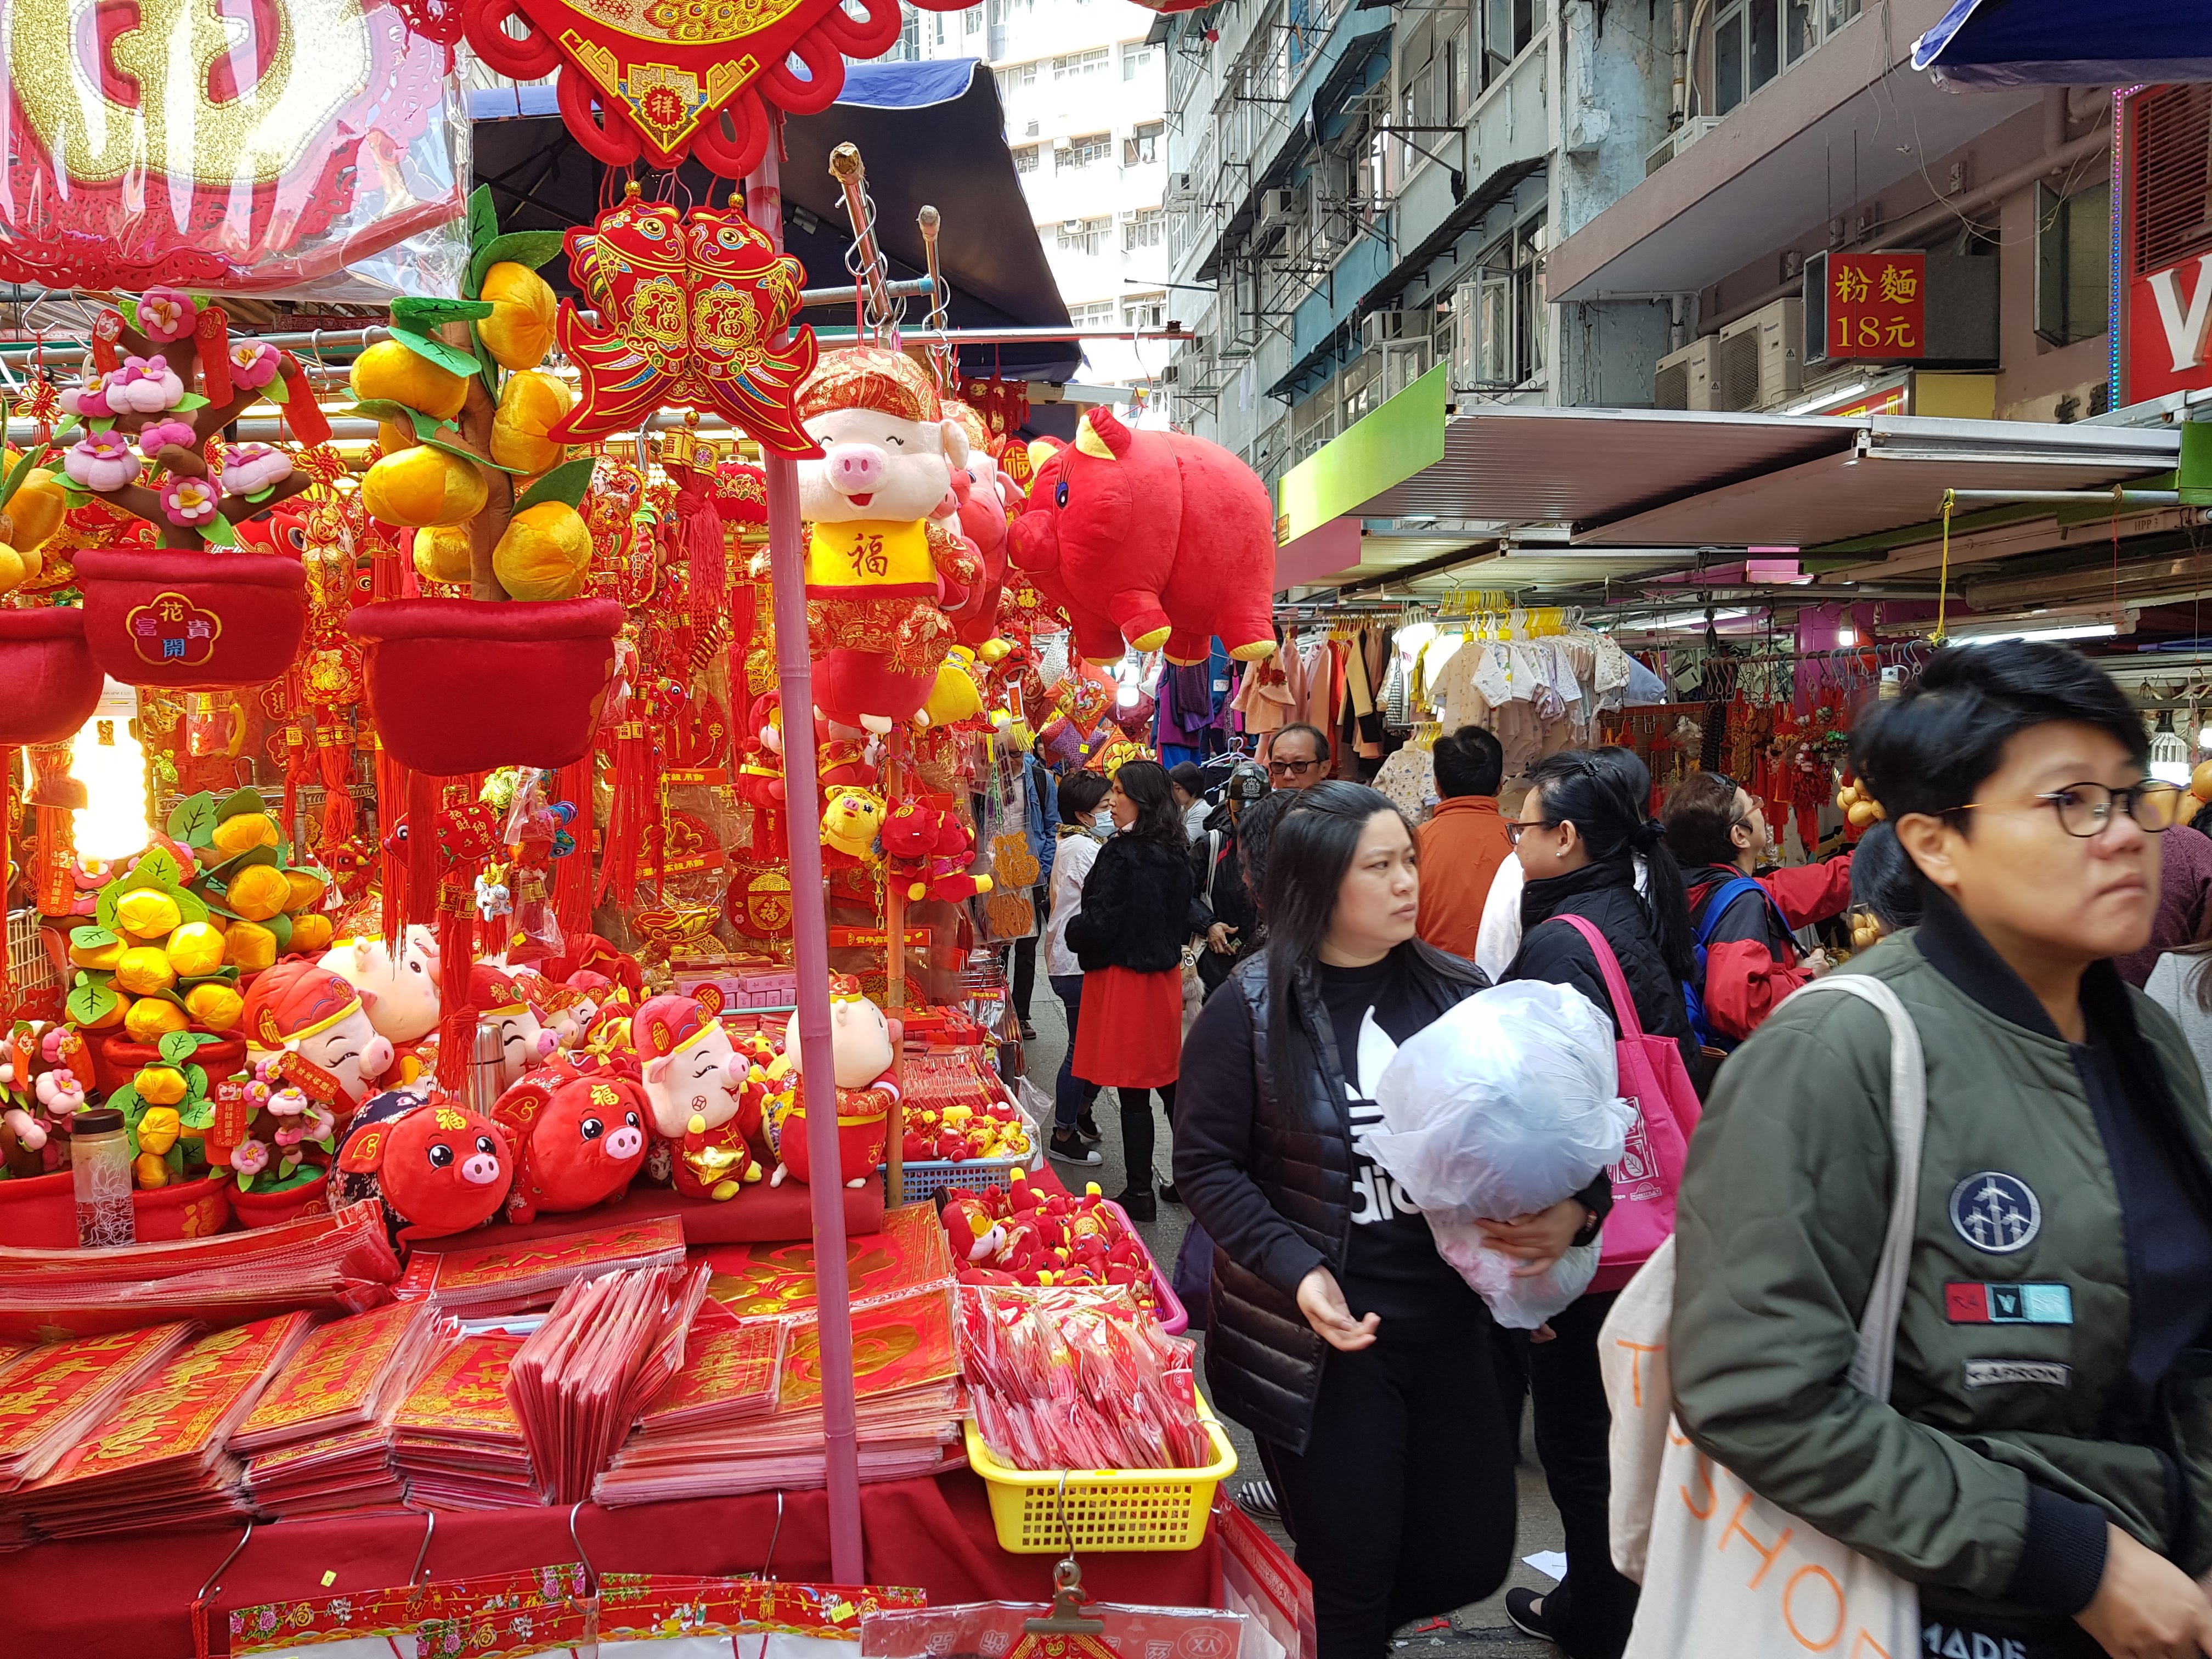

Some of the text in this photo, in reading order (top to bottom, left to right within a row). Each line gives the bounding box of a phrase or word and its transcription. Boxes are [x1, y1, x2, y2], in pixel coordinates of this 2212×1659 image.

[651, 93, 676, 123] 祥
[1835, 264, 1917, 304] 粉麵
[640, 290, 682, 334] 福
[702, 299, 746, 340] 福
[1837, 315, 1916, 348] 18元
[1003, 446, 1031, 480] 福
[848, 533, 888, 578] 福
[159, 601, 184, 623] 花
[1017, 588, 1037, 608] 福
[135, 617, 212, 639] 富 貴
[162, 637, 185, 658] 開
[760, 901, 779, 922] 福
[590, 1084, 619, 1107] 福
[436, 1108, 468, 1131] 福
[473, 1232, 651, 1272] 出入平安
